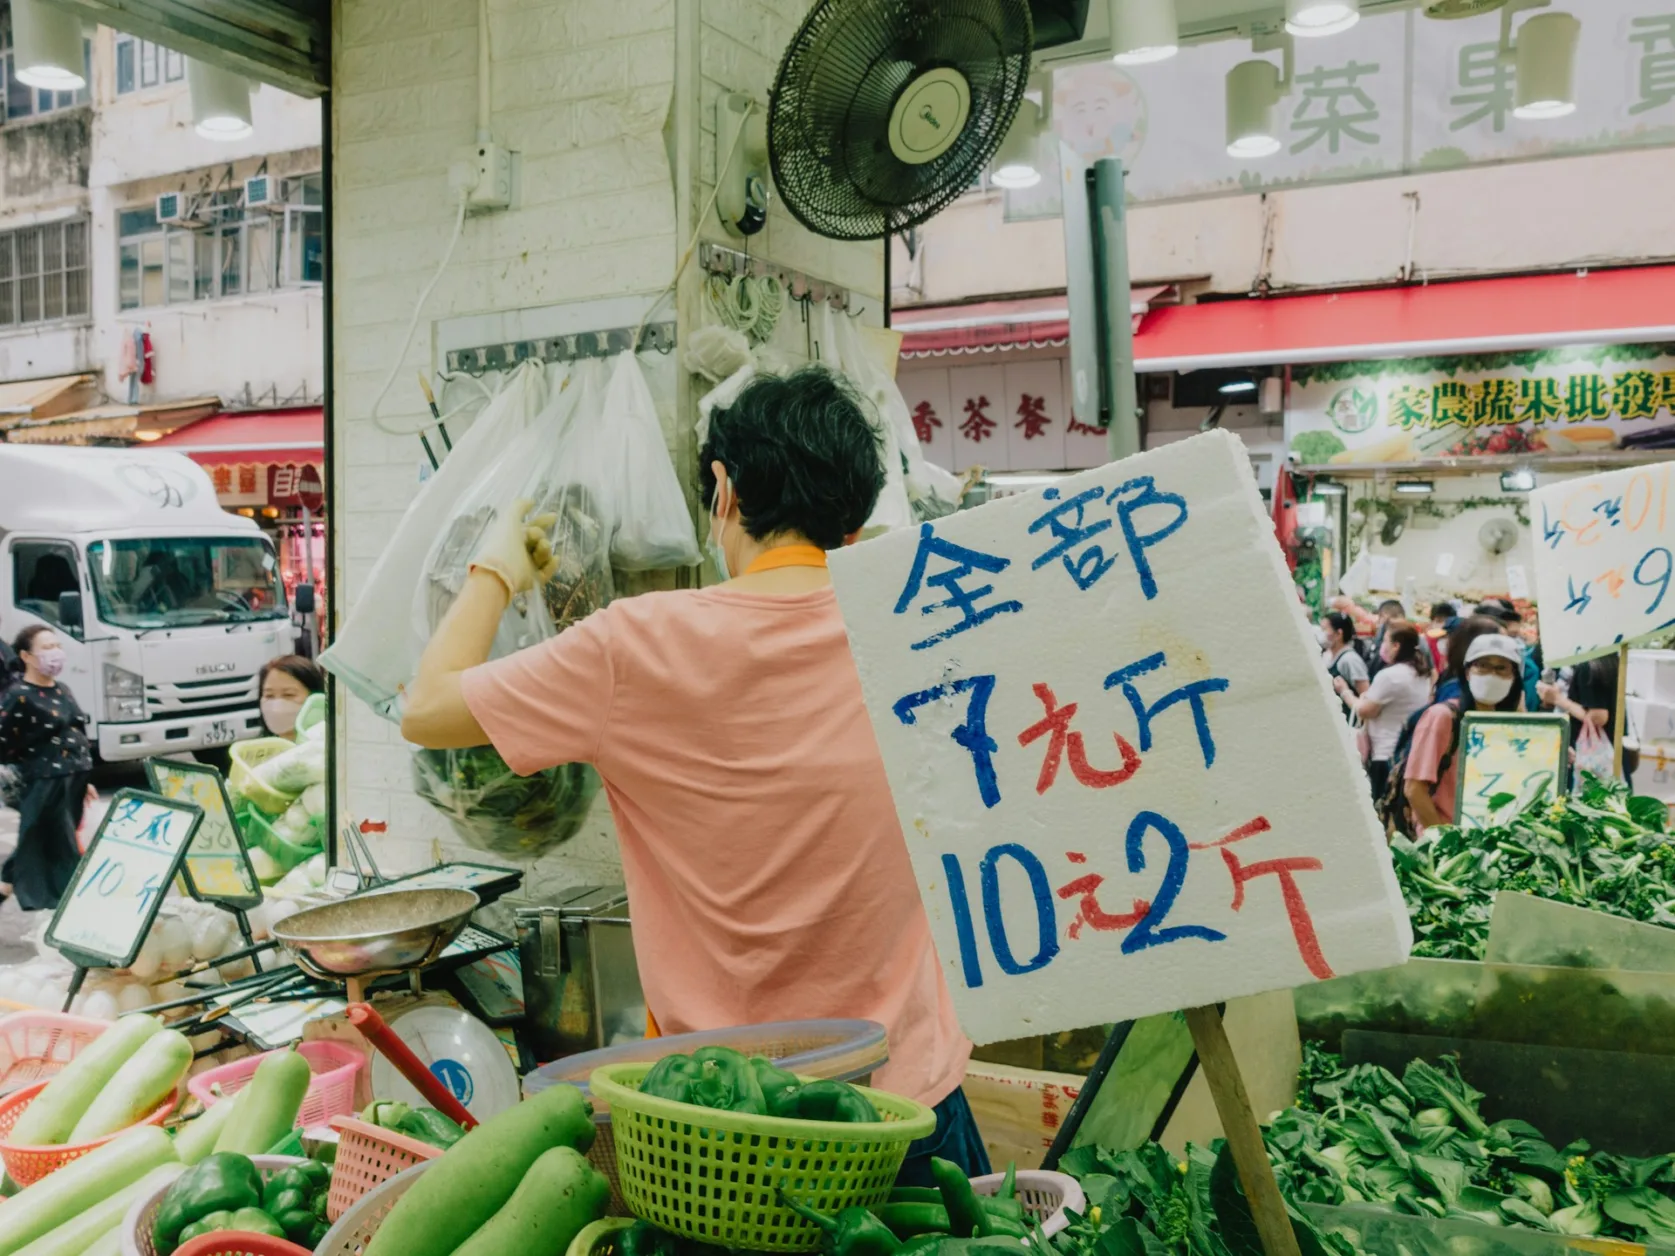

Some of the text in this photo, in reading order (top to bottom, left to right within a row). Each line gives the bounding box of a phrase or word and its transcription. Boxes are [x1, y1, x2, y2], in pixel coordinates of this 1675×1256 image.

[893, 475, 1188, 651] 全部
[892, 651, 1230, 808] 7元斤
[941, 810, 1337, 989] 10元2斤
